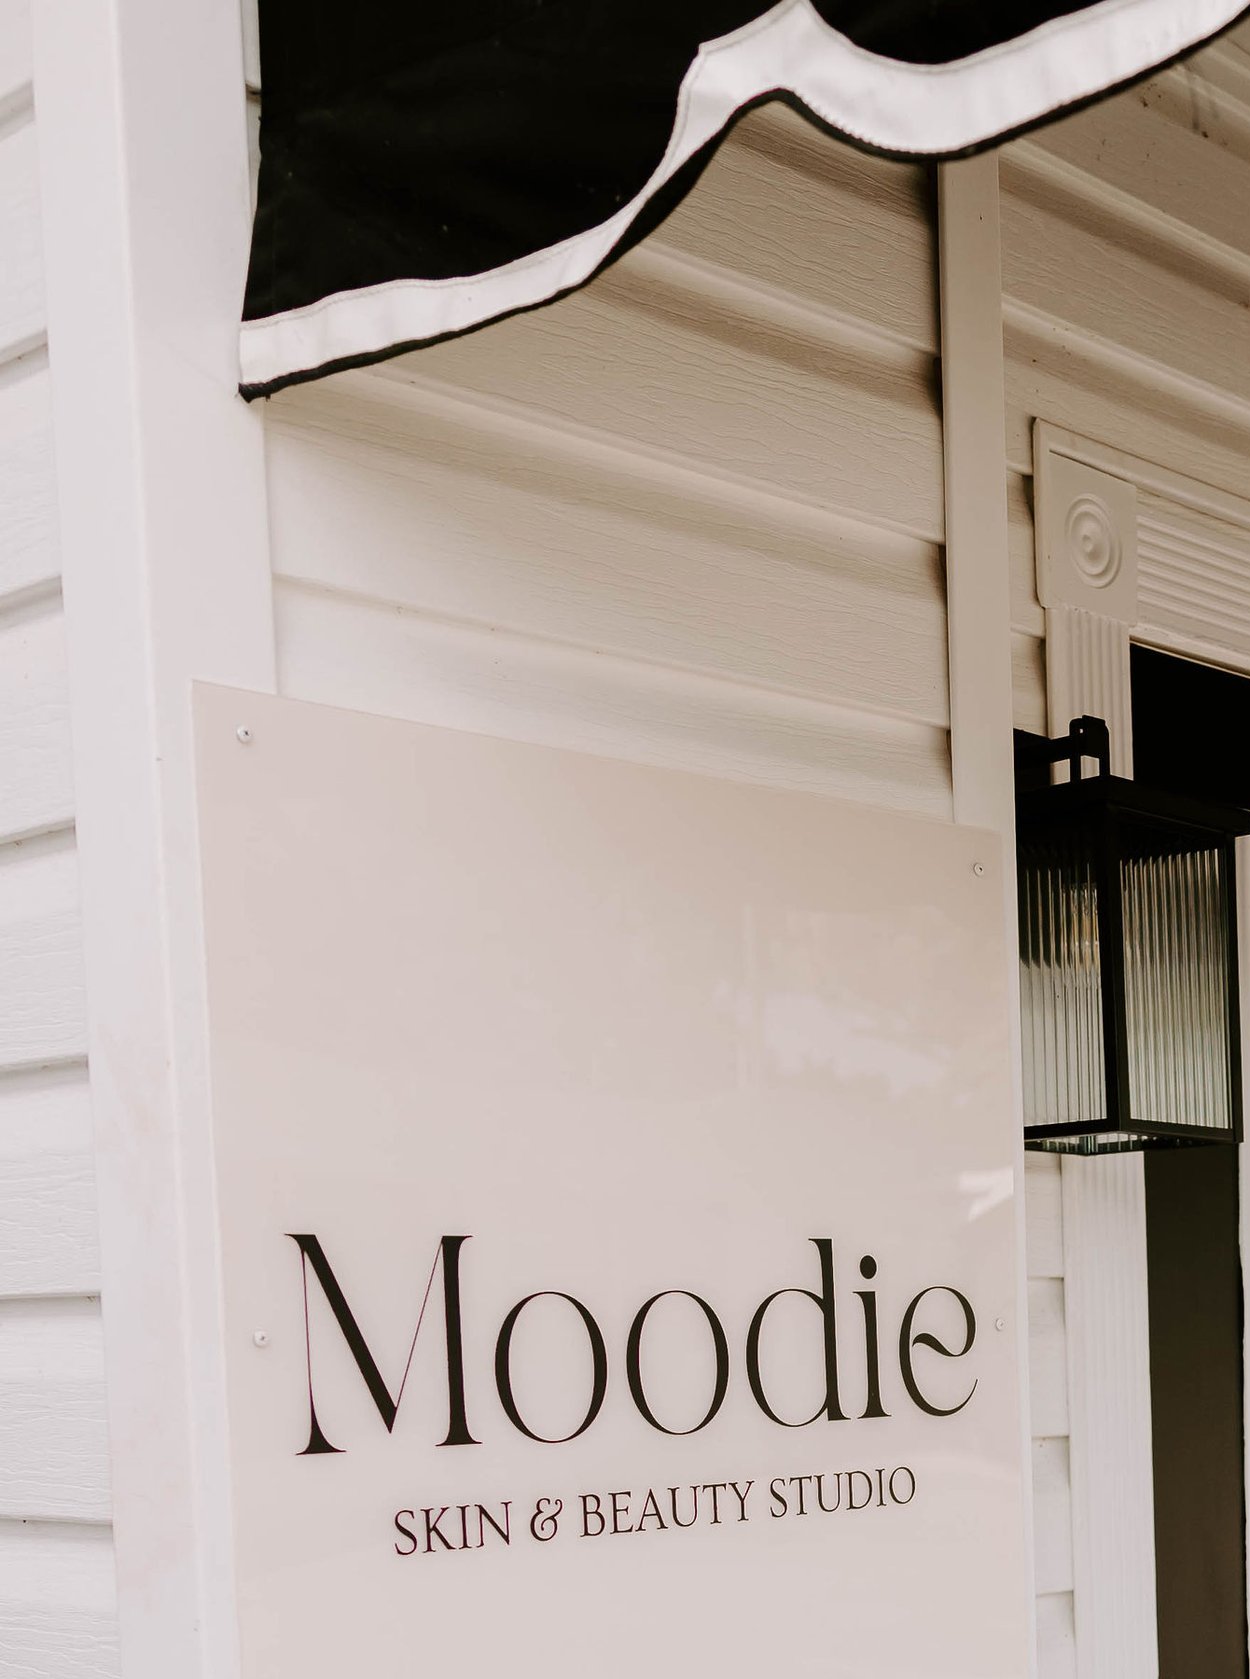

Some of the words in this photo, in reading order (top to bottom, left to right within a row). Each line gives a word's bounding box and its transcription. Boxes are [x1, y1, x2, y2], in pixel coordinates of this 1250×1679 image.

[283, 1233, 979, 1456] Moodie
[394, 1500, 513, 1556] SKIN
[529, 1497, 563, 1542] &
[577, 1480, 756, 1538] BEAUTY
[769, 1466, 917, 1519] STUDIO
